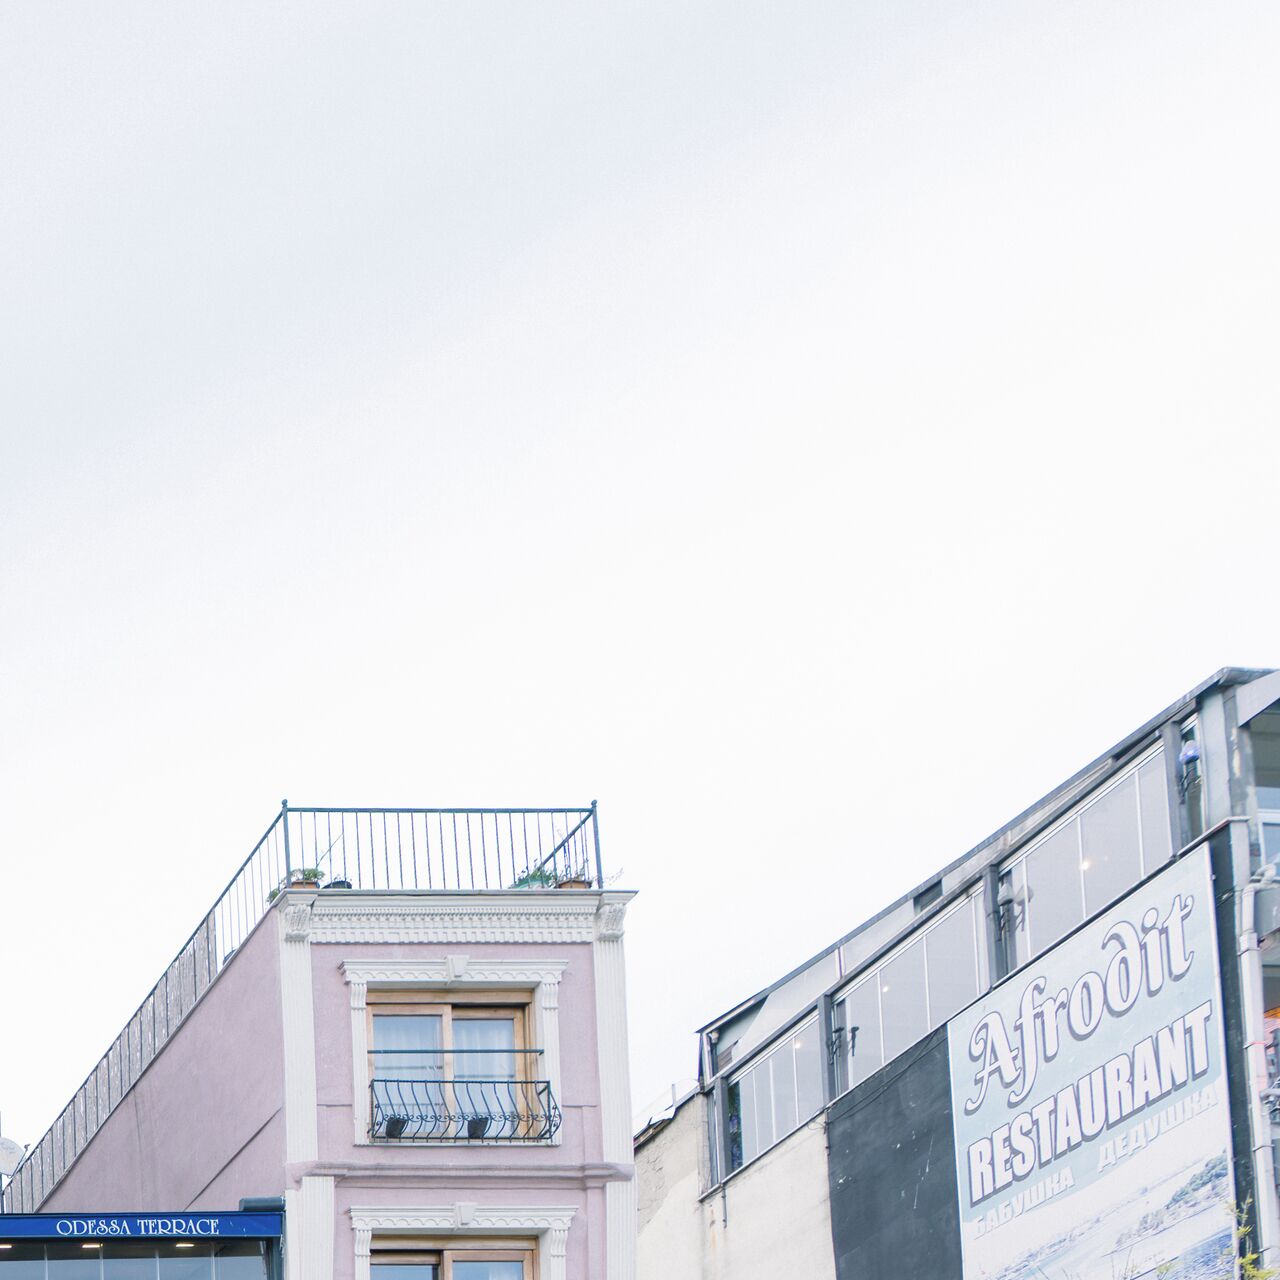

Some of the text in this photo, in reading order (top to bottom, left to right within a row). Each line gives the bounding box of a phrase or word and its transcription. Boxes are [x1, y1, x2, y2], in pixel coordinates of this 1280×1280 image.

[965, 893, 1196, 1115] Afrodit
[968, 1000, 1213, 1207] RESTAURANT
[973, 1082, 1218, 1239] БАБУШКА ДЕДУШКА
[56, 1219, 219, 1235] ODESSA TERRACE
